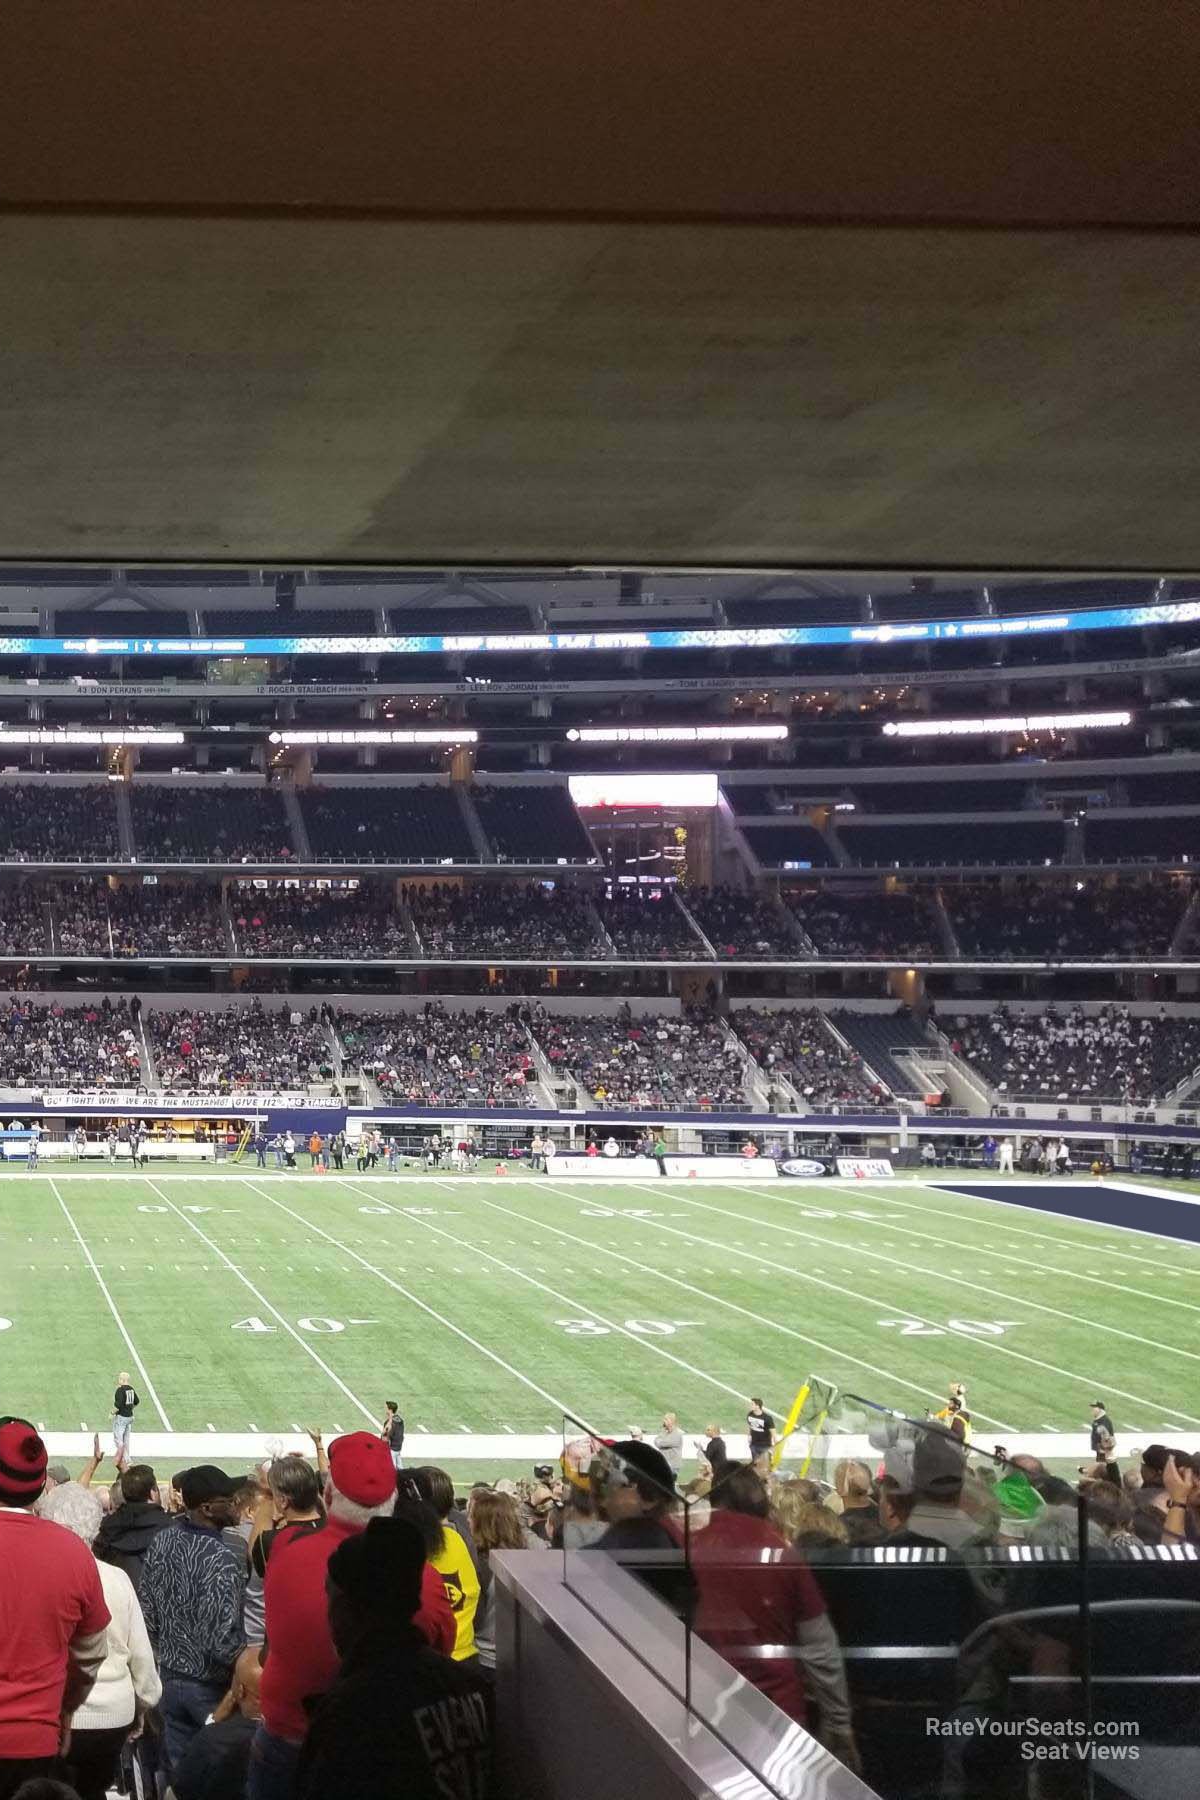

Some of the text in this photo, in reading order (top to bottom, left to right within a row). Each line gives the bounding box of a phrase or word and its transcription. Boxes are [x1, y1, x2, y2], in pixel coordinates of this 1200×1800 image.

[470, 684, 484, 692] LEE
[504, 683, 538, 692] JORDAN
[679, 680, 698, 688] TOM
[256, 686, 265, 694] 12
[268, 686, 295, 694] ROGER
[297, 686, 337, 694] STAUBACH
[65, 1096, 95, 1105] FIGHT!
[98, 1096, 120, 1105] WIN!
[125, 1097, 139, 1105] WE
[142, 1098, 159, 1106] ARE
[162, 1098, 179, 1106] THE
[235, 1097, 258, 1106] GIVE
[230, 1316, 346, 1333] 40
[554, 1319, 677, 1335] 30
[876, 1319, 1005, 1336] 20
[412, 1691, 488, 1762] EVENT
